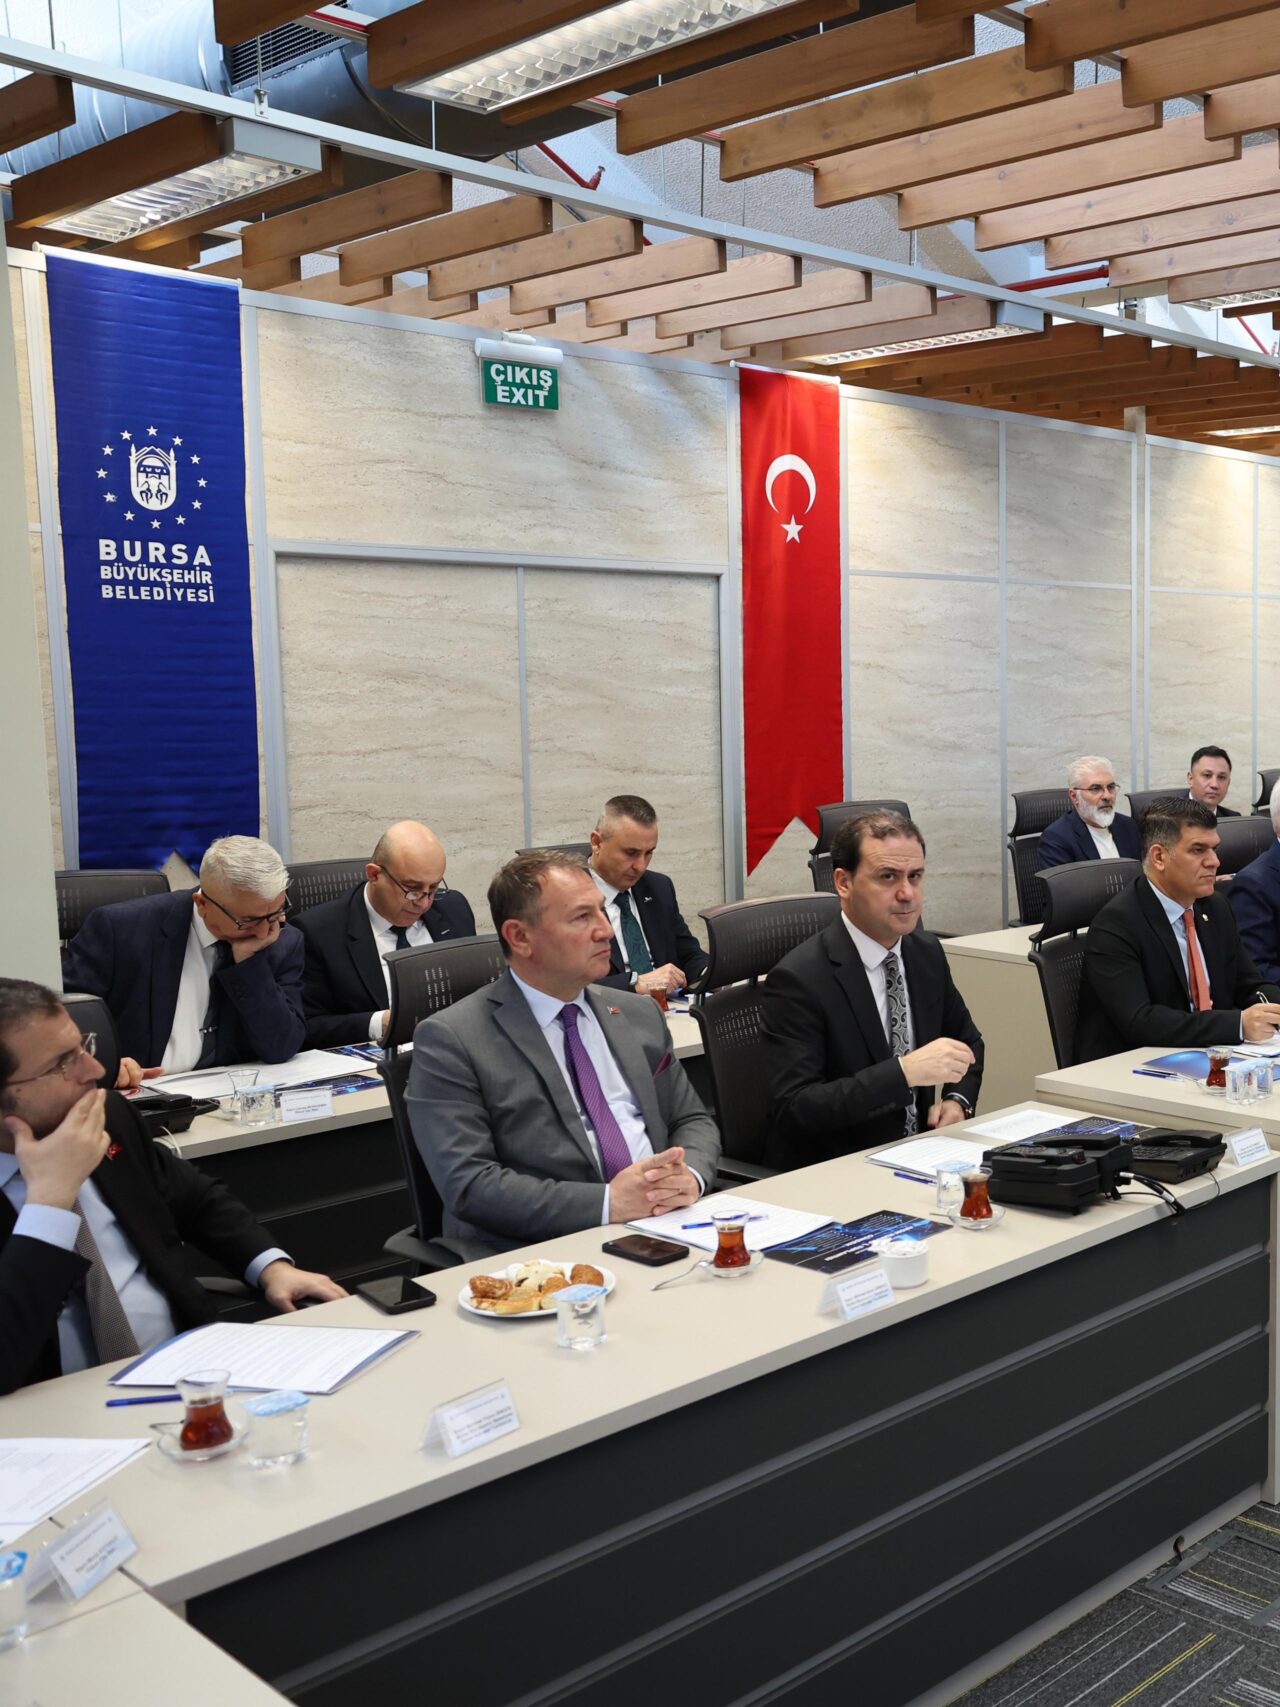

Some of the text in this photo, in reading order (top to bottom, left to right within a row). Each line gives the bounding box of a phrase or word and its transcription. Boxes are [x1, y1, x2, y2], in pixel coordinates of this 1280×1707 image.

[490, 363, 553, 390] ÇIKIŞ
[496, 385, 549, 407] EXIT
[98, 538, 212, 566] BURSA
[100, 562, 213, 584] BÜYÜKŞEHİR
[101, 583, 215, 602] BELEDİYESİ
